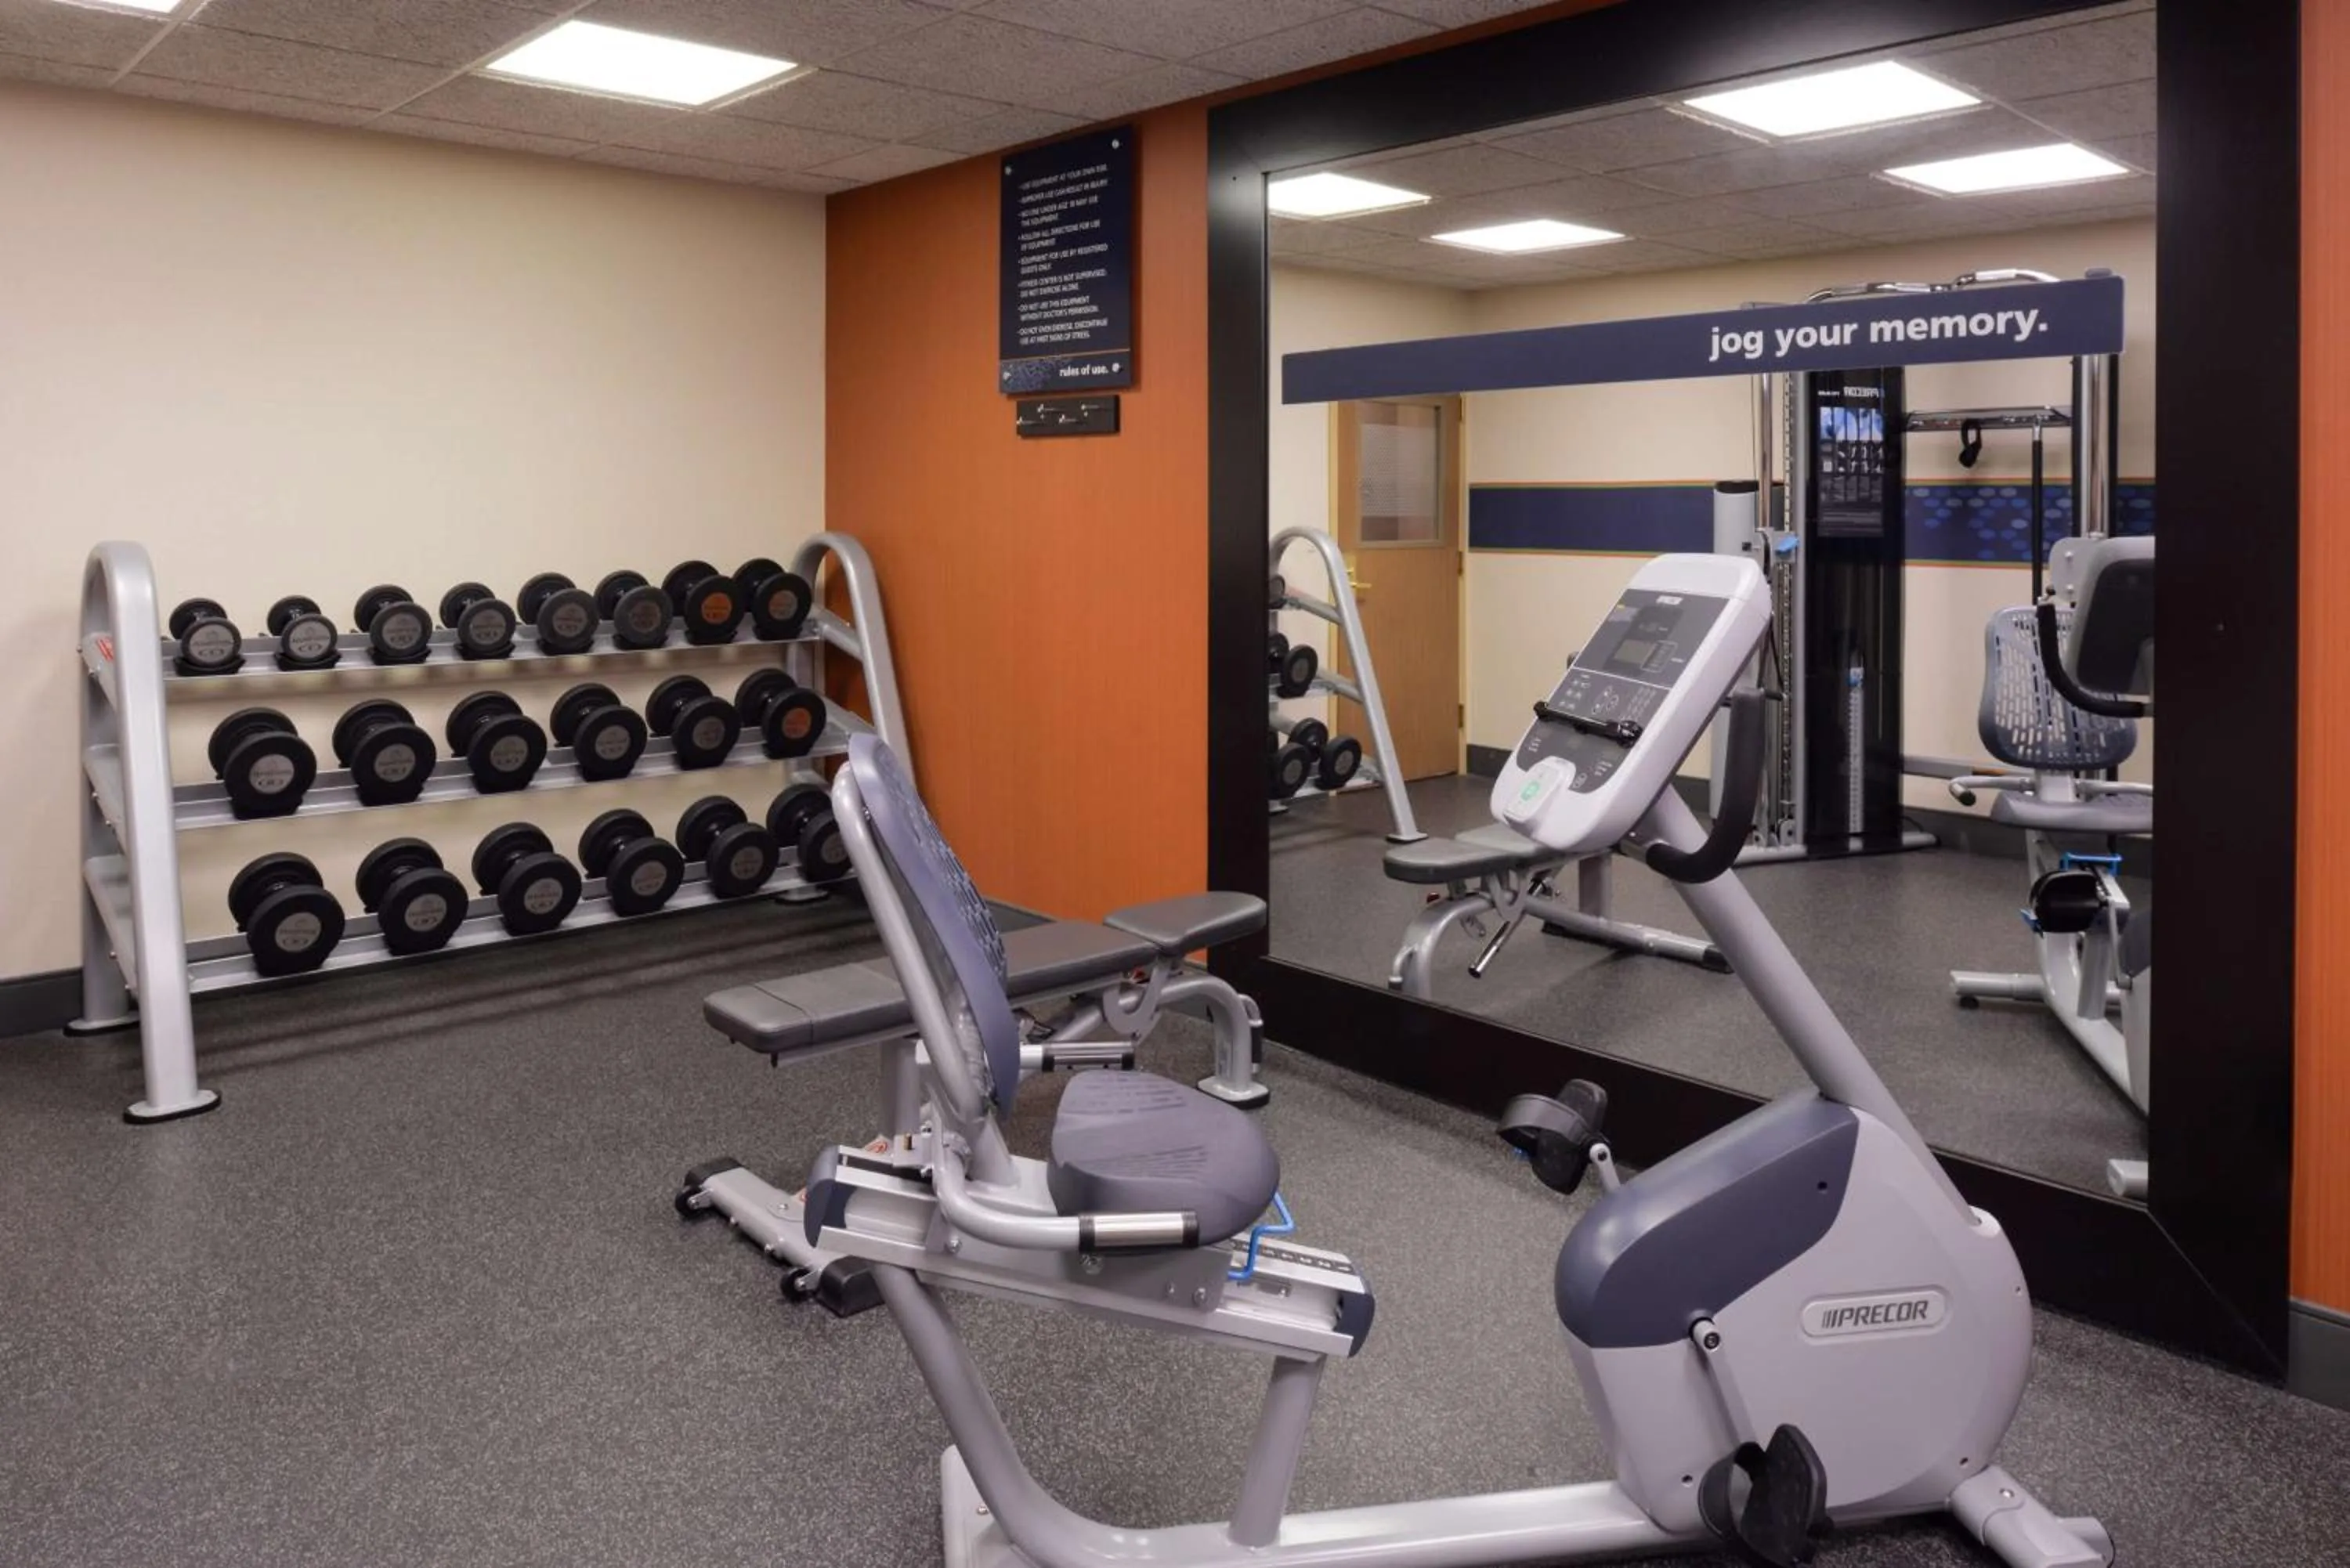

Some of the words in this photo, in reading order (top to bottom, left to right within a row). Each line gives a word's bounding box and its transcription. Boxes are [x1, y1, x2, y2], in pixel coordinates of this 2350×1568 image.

[1709, 326, 1763, 362] jog
[1774, 323, 1858, 357] your
[1870, 309, 2048, 342] memory.
[1059, 364, 1079, 376] rules
[1081, 364, 1090, 375] of
[1092, 366, 1109, 374] use.
[1838, 1300, 1929, 1328] PRECOR
